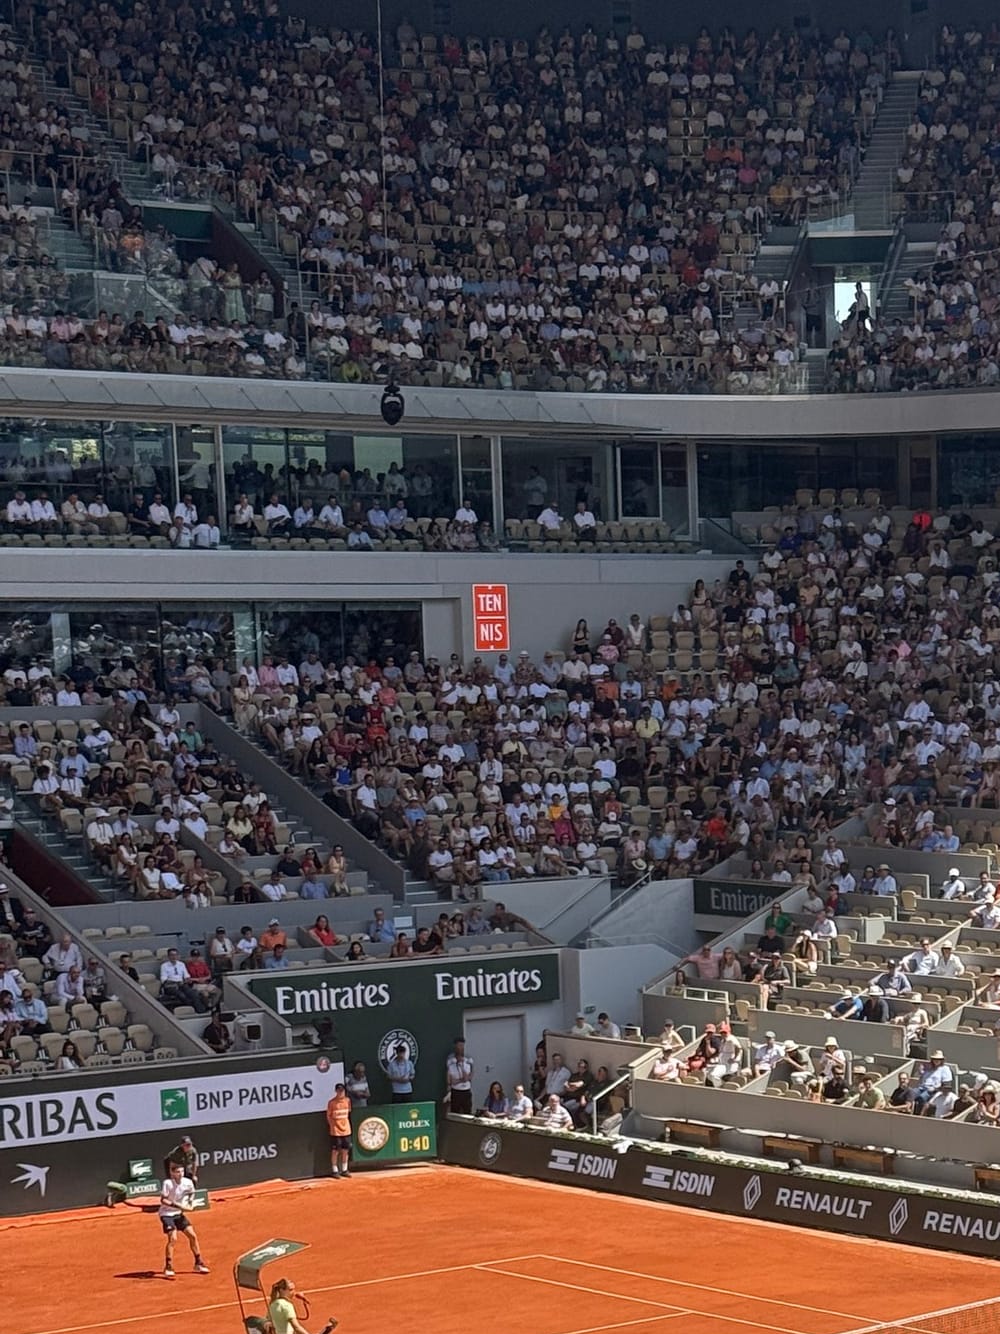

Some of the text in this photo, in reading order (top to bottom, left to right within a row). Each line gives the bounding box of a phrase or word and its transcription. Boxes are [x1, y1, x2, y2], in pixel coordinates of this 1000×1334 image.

[477, 593, 502, 612] TEN
[480, 623, 503, 642] NIS
[711, 887, 776, 912] Emirate
[275, 968, 542, 1015] Emirates Emirates
[0, 1081, 314, 1141] RIBAS BNP PARIBAS
[398, 1119, 431, 1129] ROLEX
[213, 1144, 278, 1165] PARIBAS
[400, 1135, 430, 1153] 0:40
[577, 1153, 715, 1197] ISDIN ISDIN
[775, 1187, 872, 1220] RENAULT
